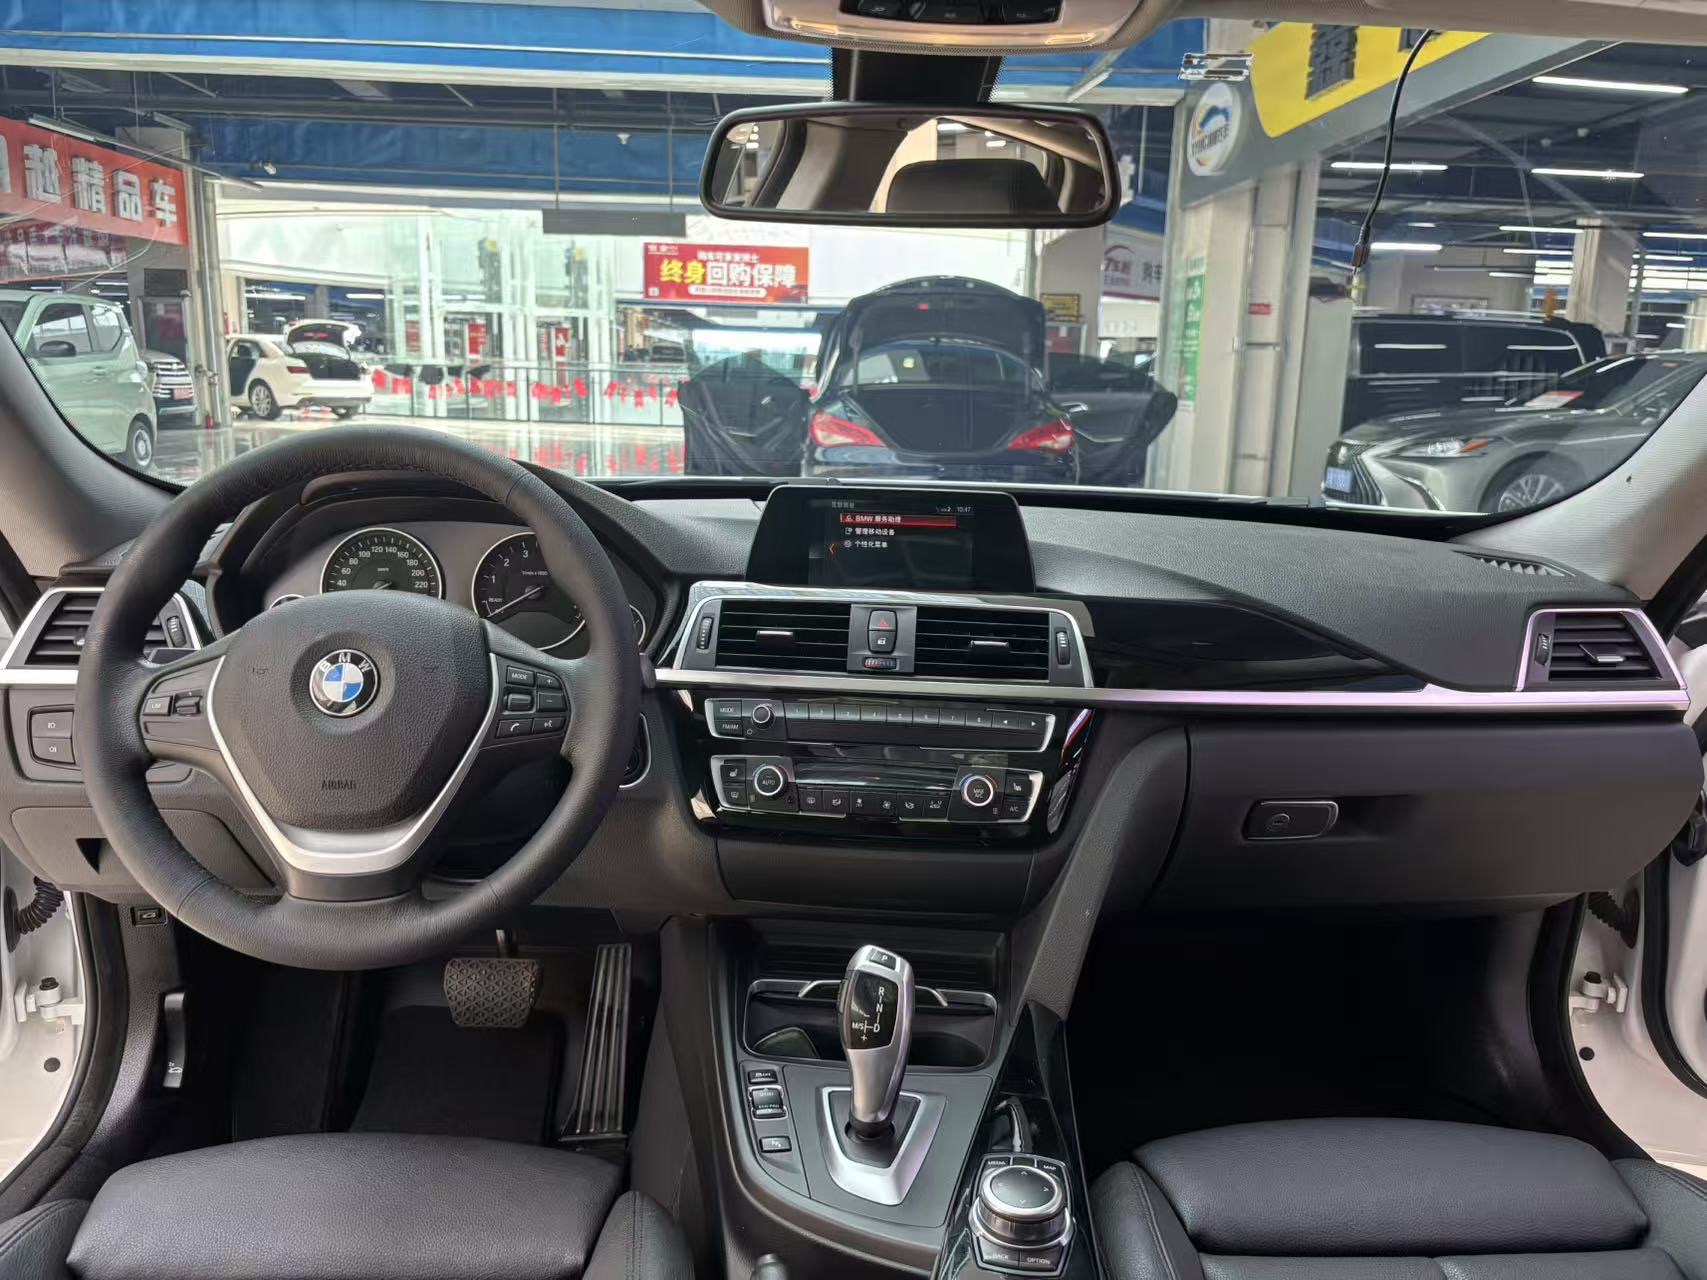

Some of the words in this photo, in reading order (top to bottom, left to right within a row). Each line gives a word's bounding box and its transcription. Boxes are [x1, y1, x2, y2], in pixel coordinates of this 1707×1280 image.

[660, 258, 797, 288] 终身回购保障
[855, 515, 874, 523] BMW
[371, 545, 384, 553] 120
[522, 549, 529, 558] 3
[358, 550, 371, 558] 100
[397, 551, 409, 559] 160
[406, 558, 419, 567] 180
[503, 558, 510, 567] 2
[341, 567, 352, 575] 60
[411, 569, 425, 577] 200
[337, 579, 347, 587] 40
[491, 575, 496, 584] 1
[319, 652, 372, 673] BMW
[511, 672, 528, 680] MODE
[321, 780, 357, 790] AIRBAG
[878, 986, 885, 996] R
[875, 1003, 884, 1013] N
[851, 1021, 864, 1030] M/S
[873, 1023, 881, 1033] D
[1026, 1256, 1051, 1265] OPTION
